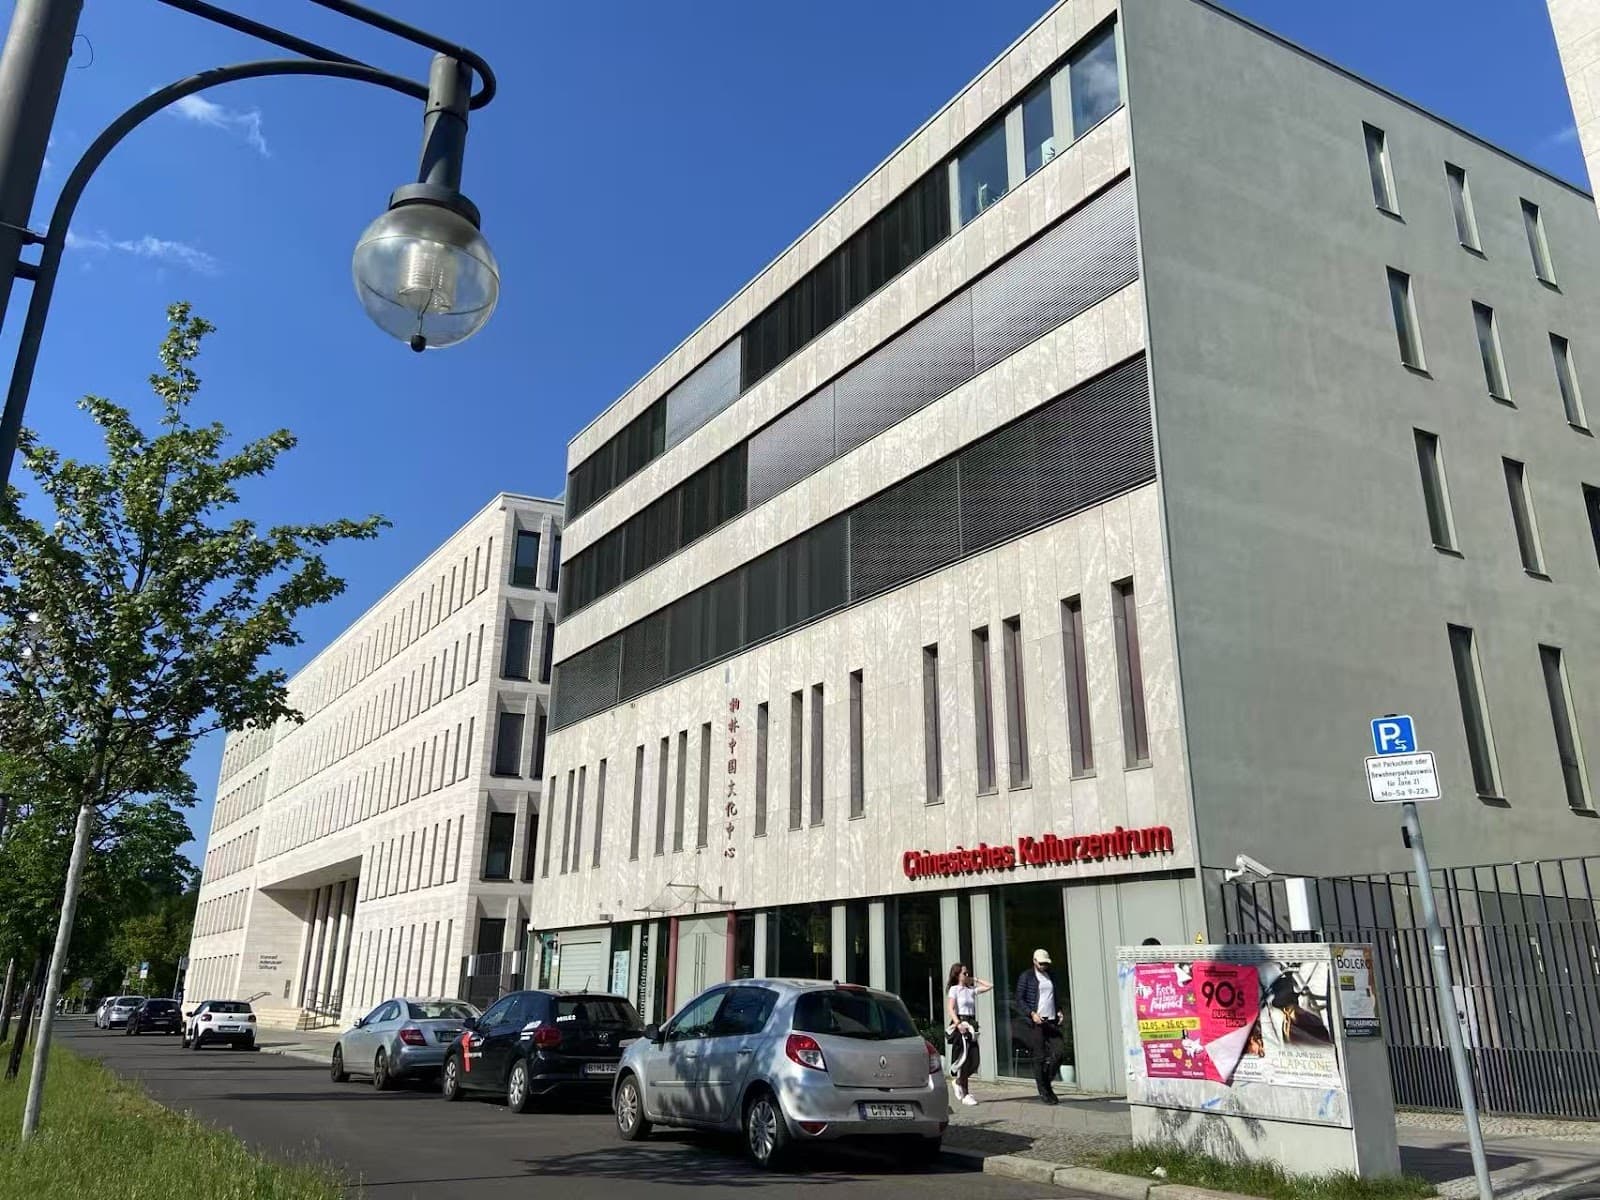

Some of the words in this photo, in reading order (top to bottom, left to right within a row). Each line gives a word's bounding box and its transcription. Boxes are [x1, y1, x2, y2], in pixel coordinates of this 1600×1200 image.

[1378, 722, 1401, 751] P
[1383, 759, 1413, 768] Parkschein
[1415, 757, 1428, 765] oder
[1371, 769, 1433, 779] Bewohnerparkausweis
[1387, 779, 1396, 787] für
[1398, 777, 1412, 786] Zone
[1381, 788, 1406, 797] Mo-Sa
[902, 843, 1016, 879] Chinesisches
[1018, 825, 1173, 867] Kulturzentrum
[1337, 954, 1372, 970] BOLERO
[1272, 1057, 1334, 1072] CLAPTONE
